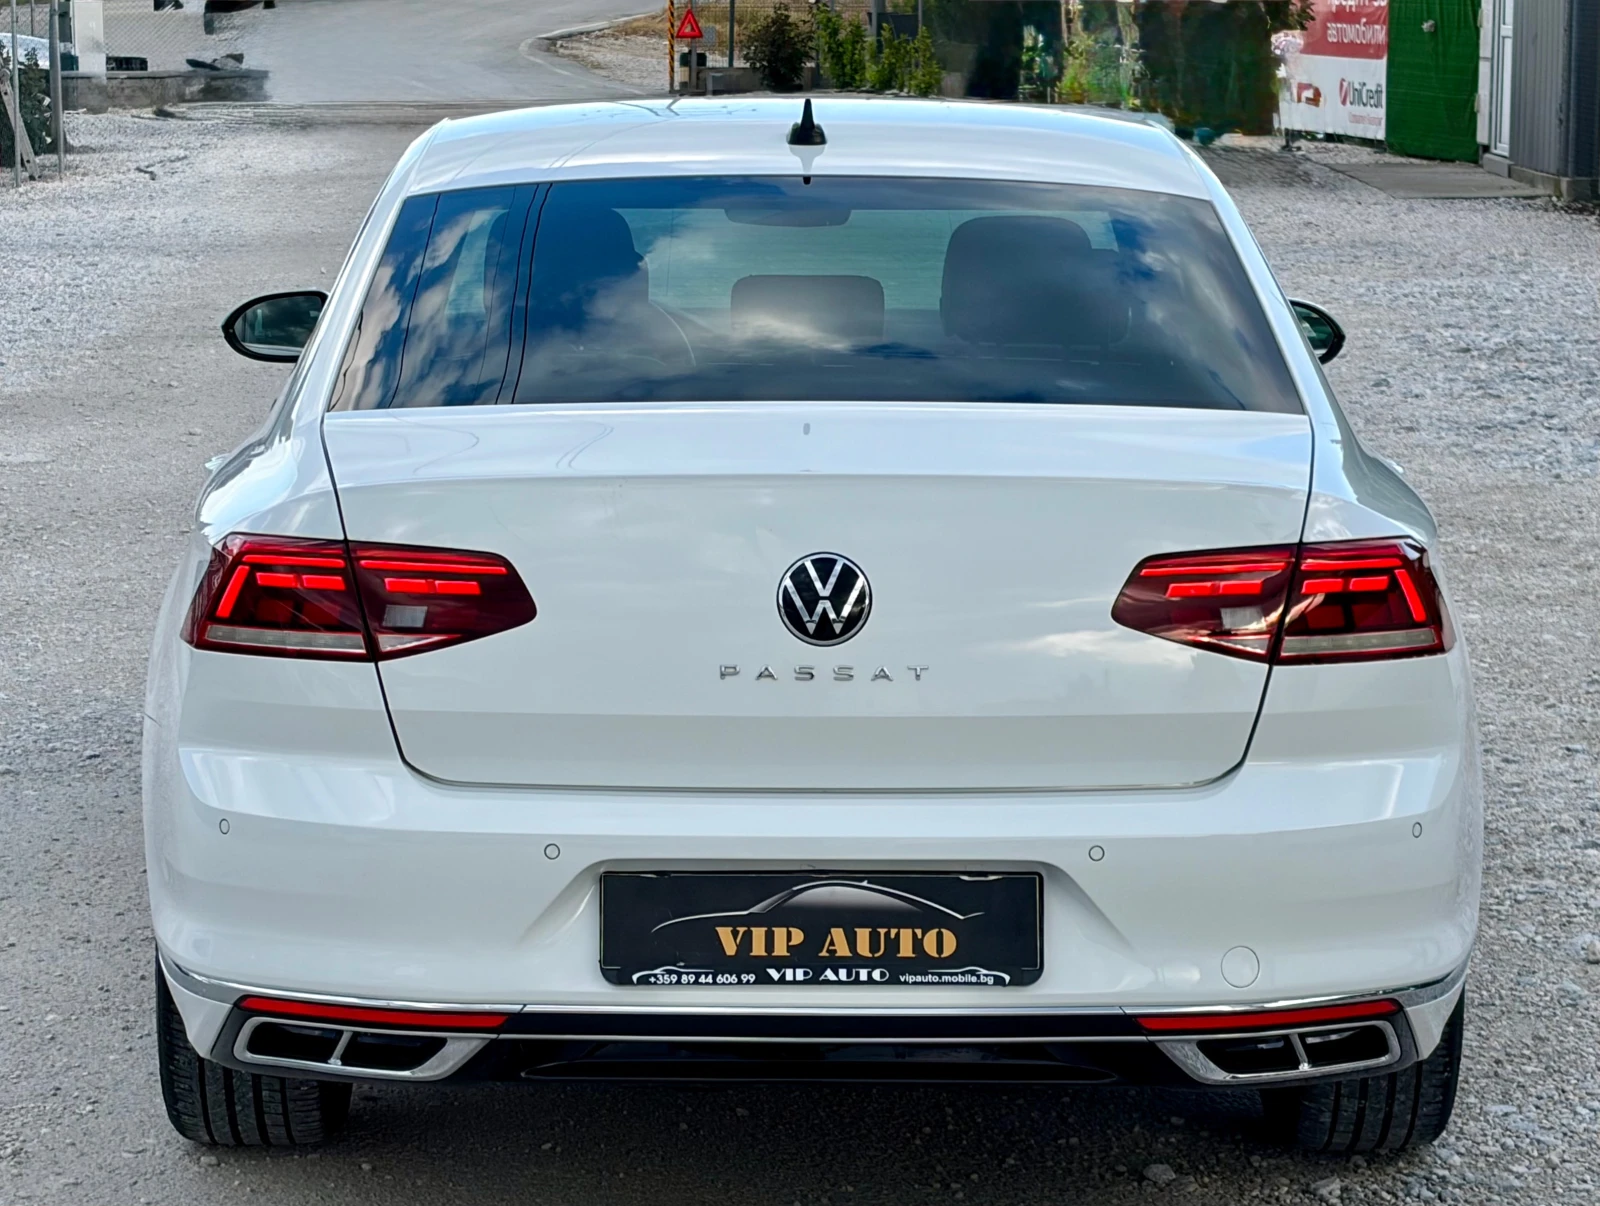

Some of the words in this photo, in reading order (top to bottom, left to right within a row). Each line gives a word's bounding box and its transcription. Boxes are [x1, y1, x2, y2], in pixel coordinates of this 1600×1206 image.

[1326, 18, 1386, 45] автомобили
[1348, 81, 1383, 109] UniCredit
[719, 664, 929, 682] PASSAT
[715, 926, 805, 957] VIP
[818, 927, 958, 959] AUTO
[648, 973, 678, 984] +359
[680, 973, 696, 984] 89
[698, 973, 714, 984] 44
[716, 973, 738, 984] 606
[740, 973, 756, 984] 99
[766, 967, 813, 982] VIP
[819, 967, 890, 982] AUTO
[899, 972, 995, 985] vipauto.mobile.bg
